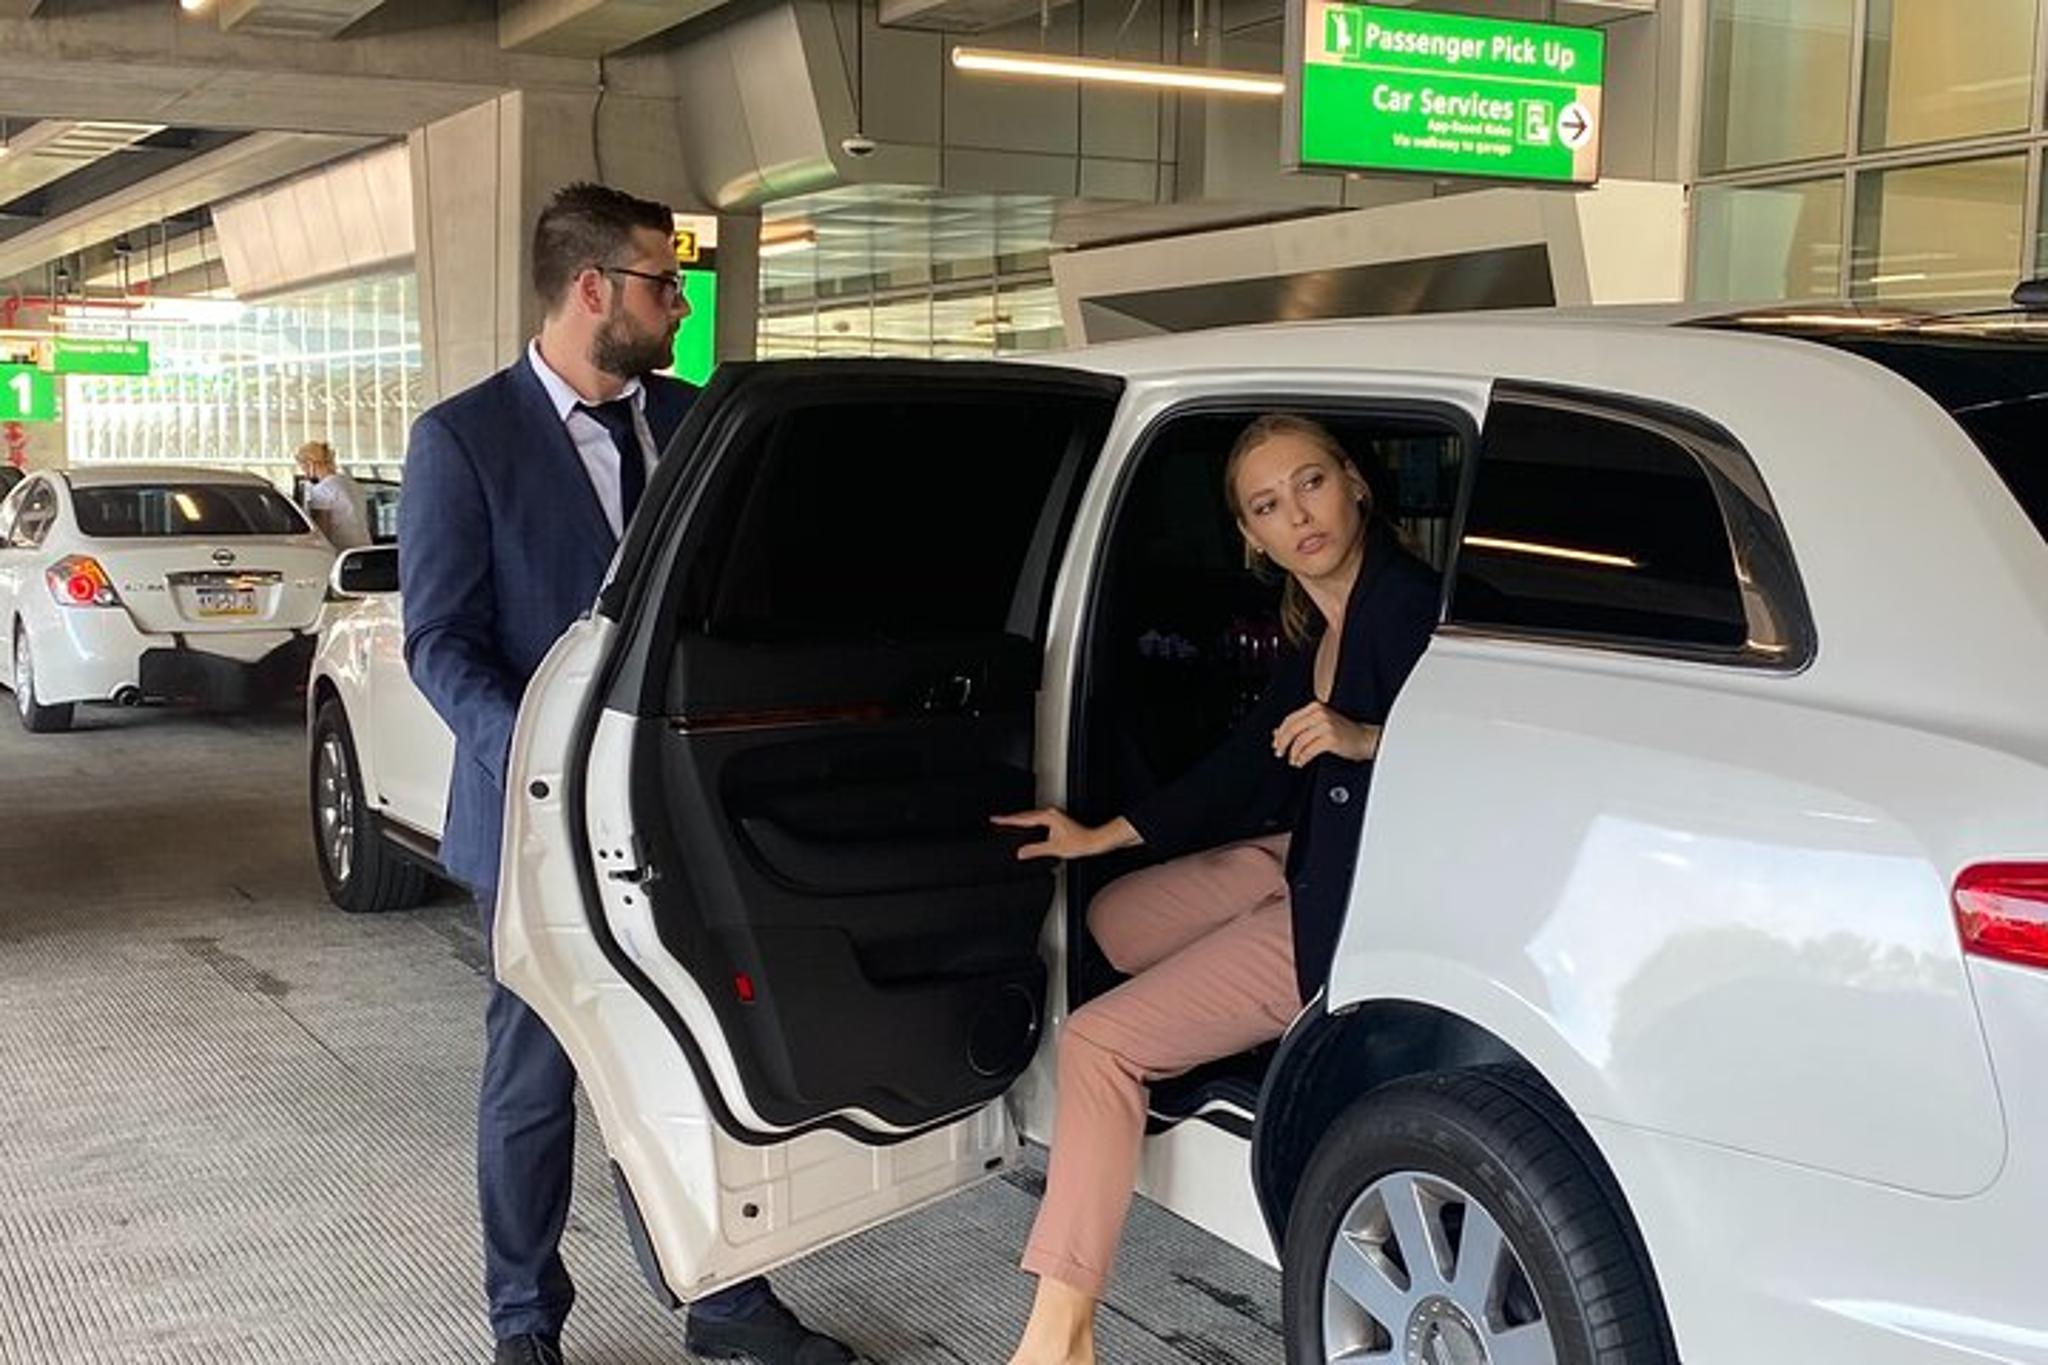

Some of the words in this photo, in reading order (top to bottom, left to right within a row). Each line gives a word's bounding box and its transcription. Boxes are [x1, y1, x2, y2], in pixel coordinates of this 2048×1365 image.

[1365, 23, 1485, 63] Passenger
[1492, 36, 1536, 65] Pick
[1543, 41, 1575, 73] Up
[1372, 84, 1414, 113] Car
[1420, 87, 1514, 120] Services
[675, 233, 692, 255] 2
[8, 372, 32, 415] 1
